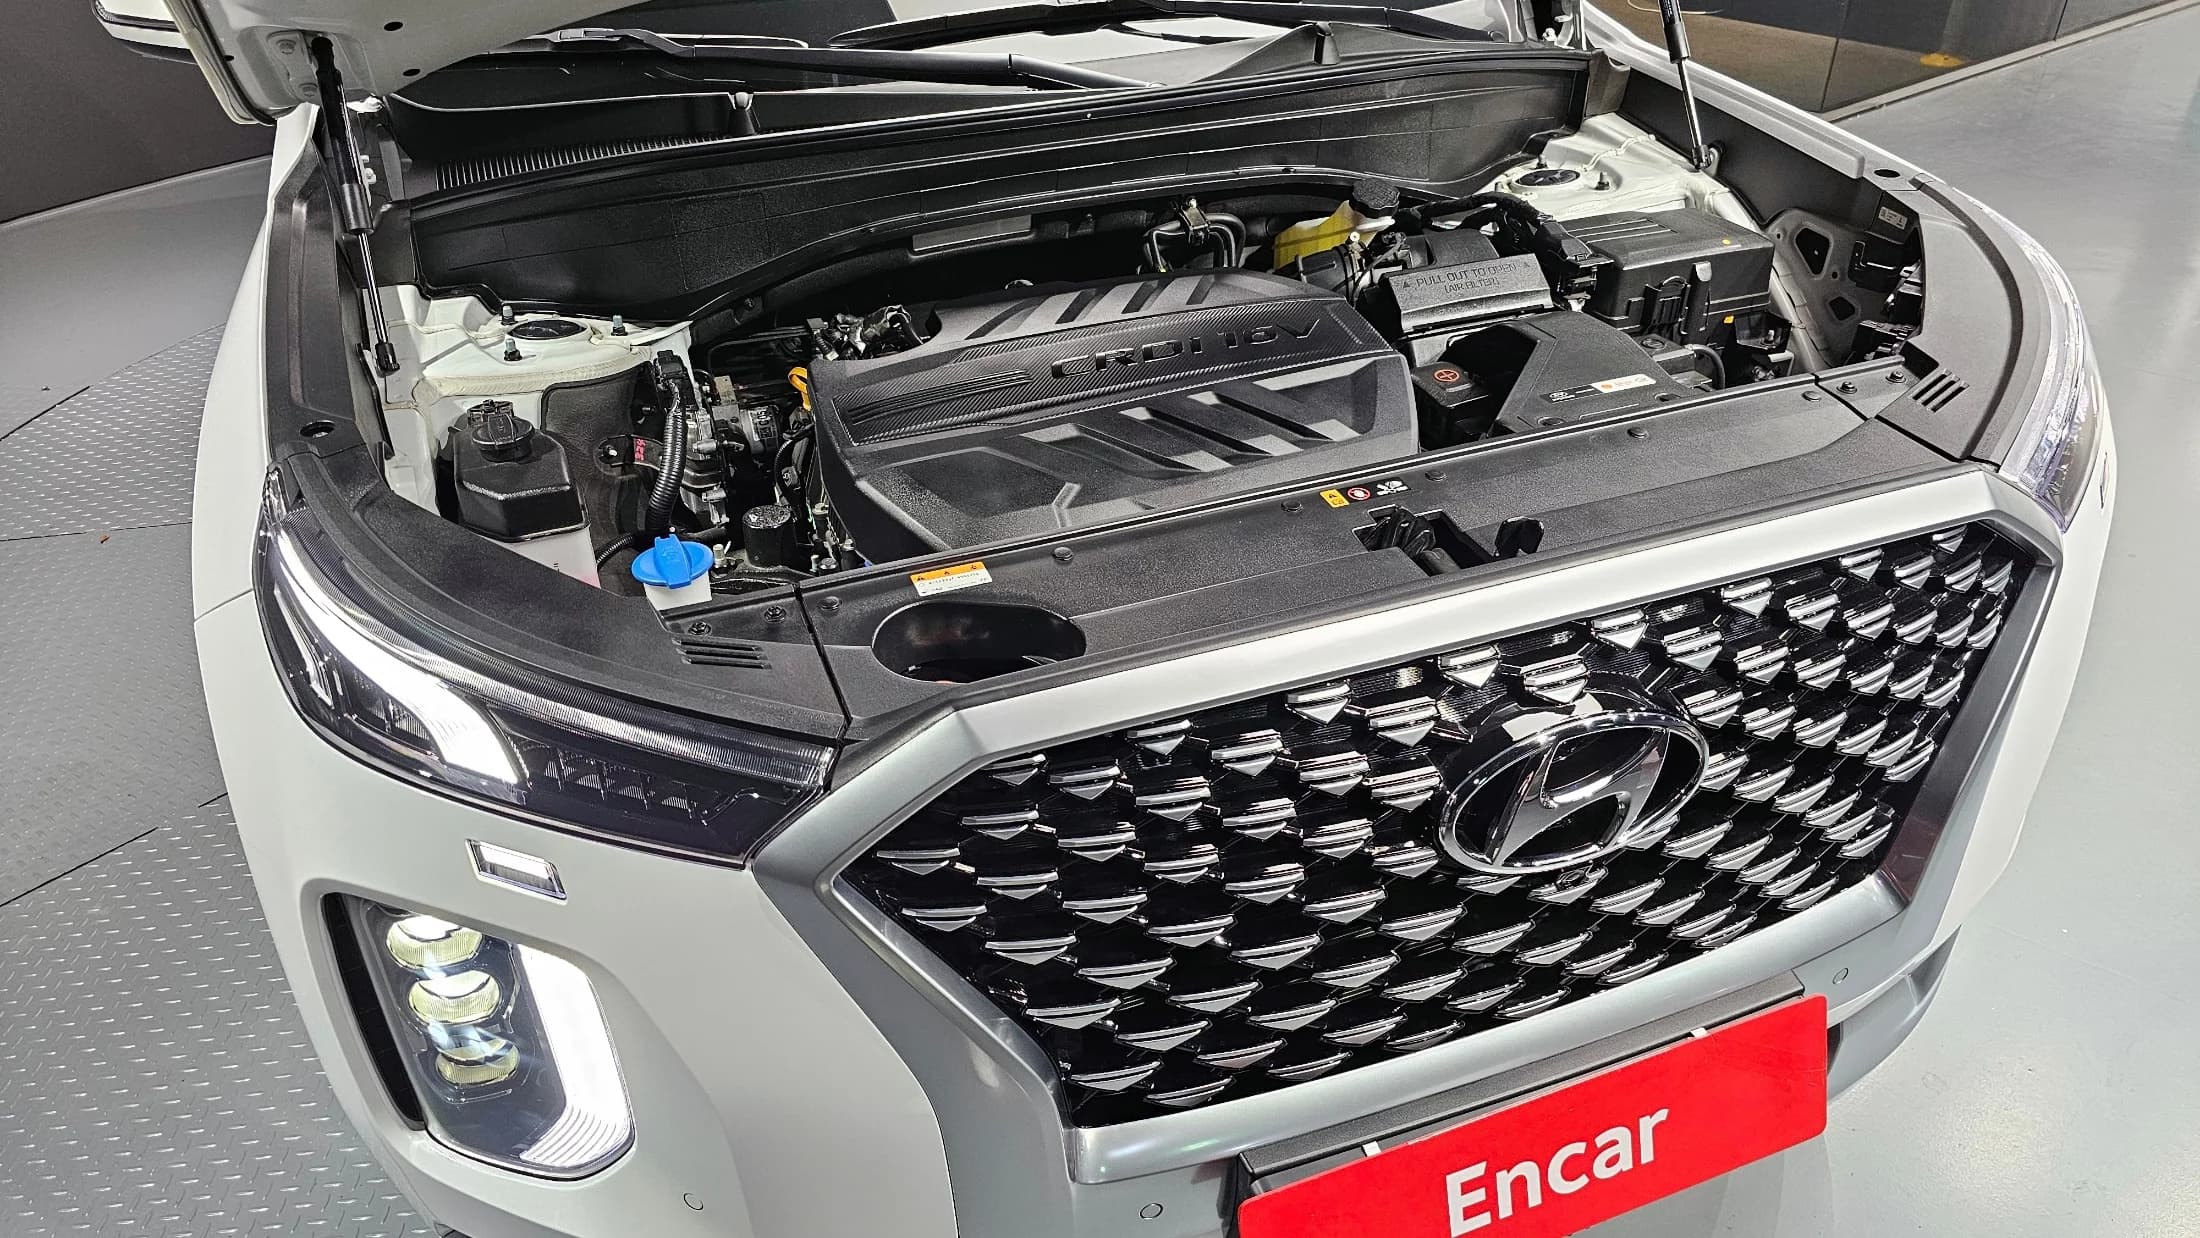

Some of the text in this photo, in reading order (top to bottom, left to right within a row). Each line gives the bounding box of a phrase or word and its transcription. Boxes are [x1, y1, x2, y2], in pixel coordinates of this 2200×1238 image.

[1416, 263, 1517, 287] PULL OUT TO OPEN
[1444, 283, 1465, 294] (AIR
[1216, 318, 1321, 349] 16V
[1445, 1108, 1669, 1238] Encar
